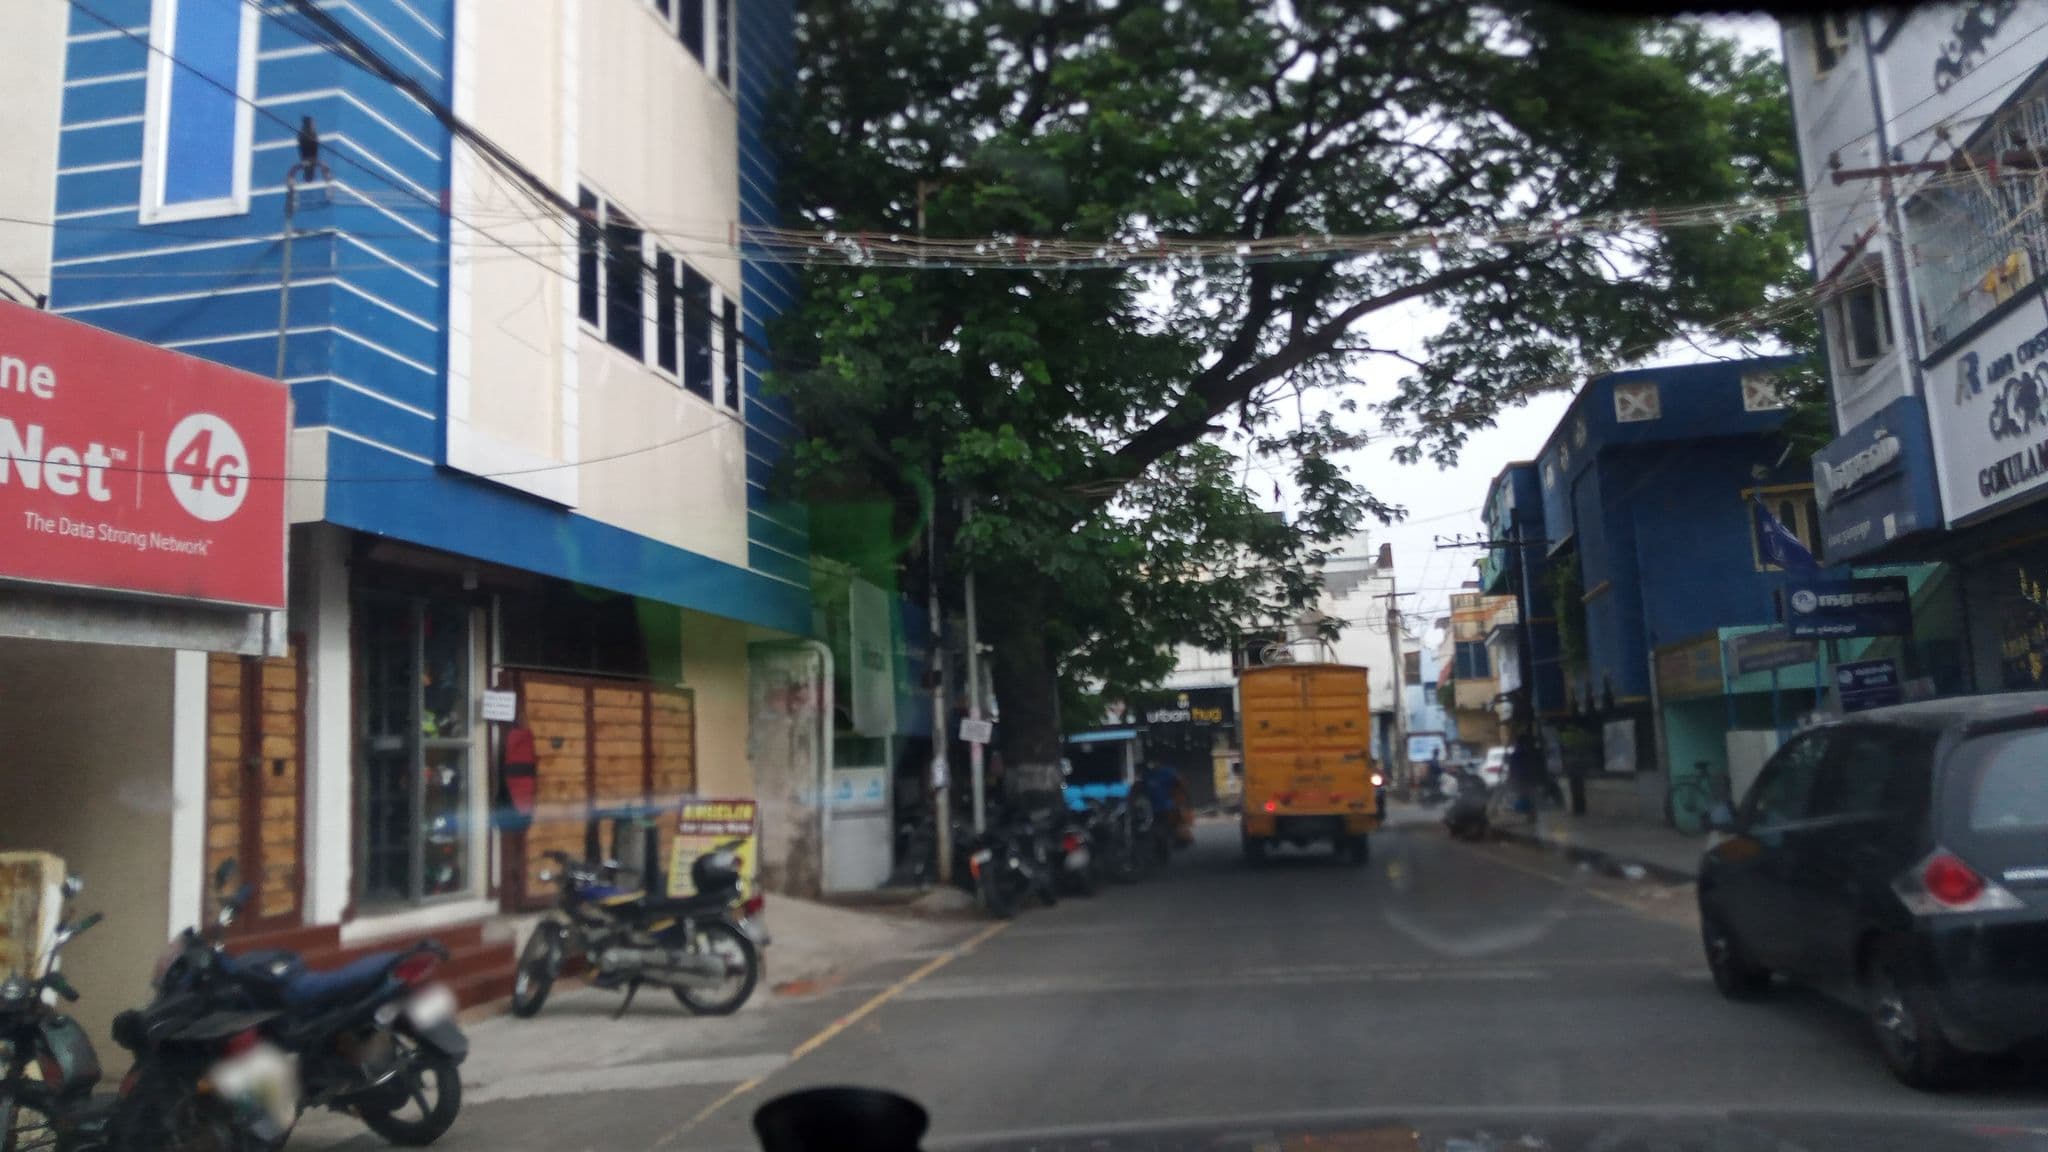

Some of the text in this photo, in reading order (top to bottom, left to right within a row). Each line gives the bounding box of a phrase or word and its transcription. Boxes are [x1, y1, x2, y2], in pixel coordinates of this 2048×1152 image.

[172, 429, 241, 497] 4G
[24, 511, 208, 556] The Data Strong Network
